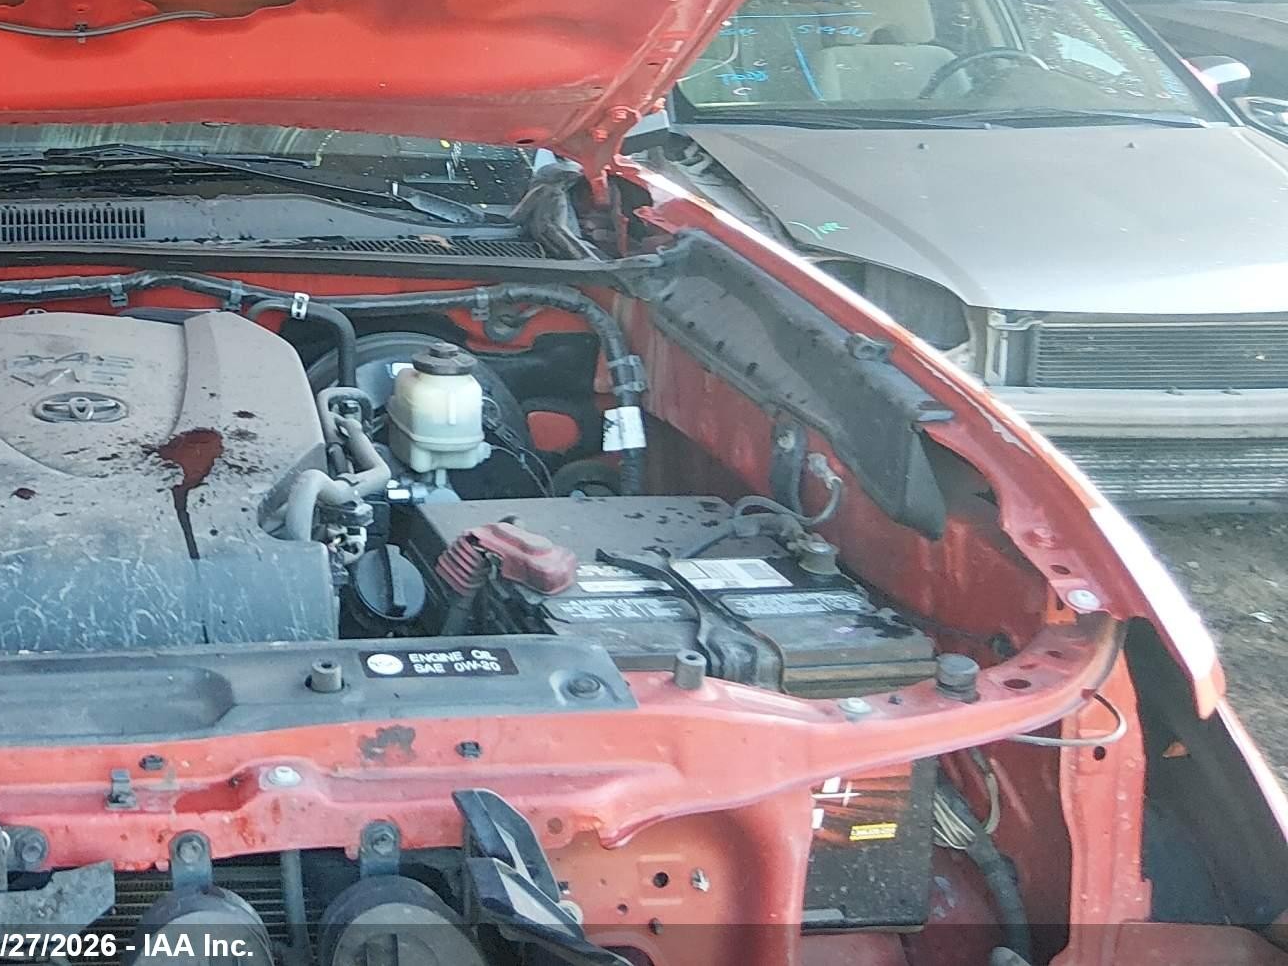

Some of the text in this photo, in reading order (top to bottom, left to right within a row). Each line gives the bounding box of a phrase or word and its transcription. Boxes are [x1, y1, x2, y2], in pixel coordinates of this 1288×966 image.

[408, 649, 499, 663] ENGINE OIL
[413, 660, 501, 674] SAE 0W-20
